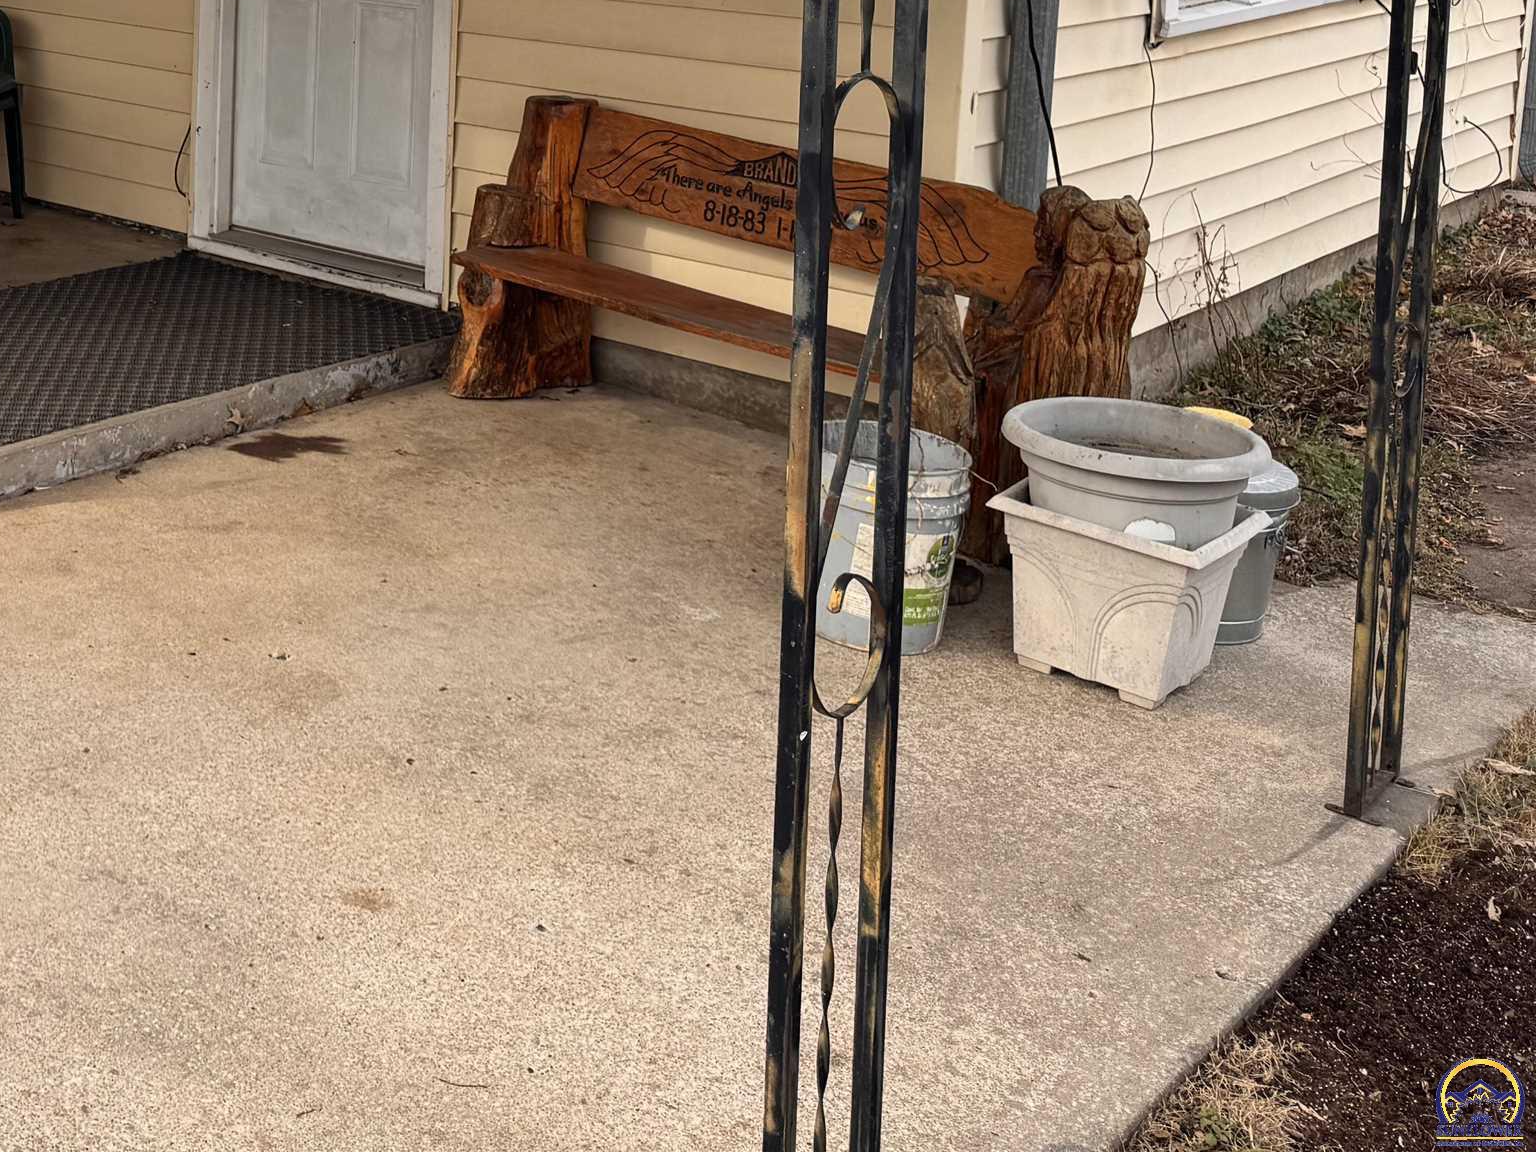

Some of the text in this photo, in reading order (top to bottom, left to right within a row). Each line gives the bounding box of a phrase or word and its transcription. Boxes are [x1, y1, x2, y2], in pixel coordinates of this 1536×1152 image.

[743, 156, 797, 185] BRAND
[706, 181, 733, 198] are
[736, 180, 794, 211] Angels
[703, 199, 766, 235] 8-18-83
